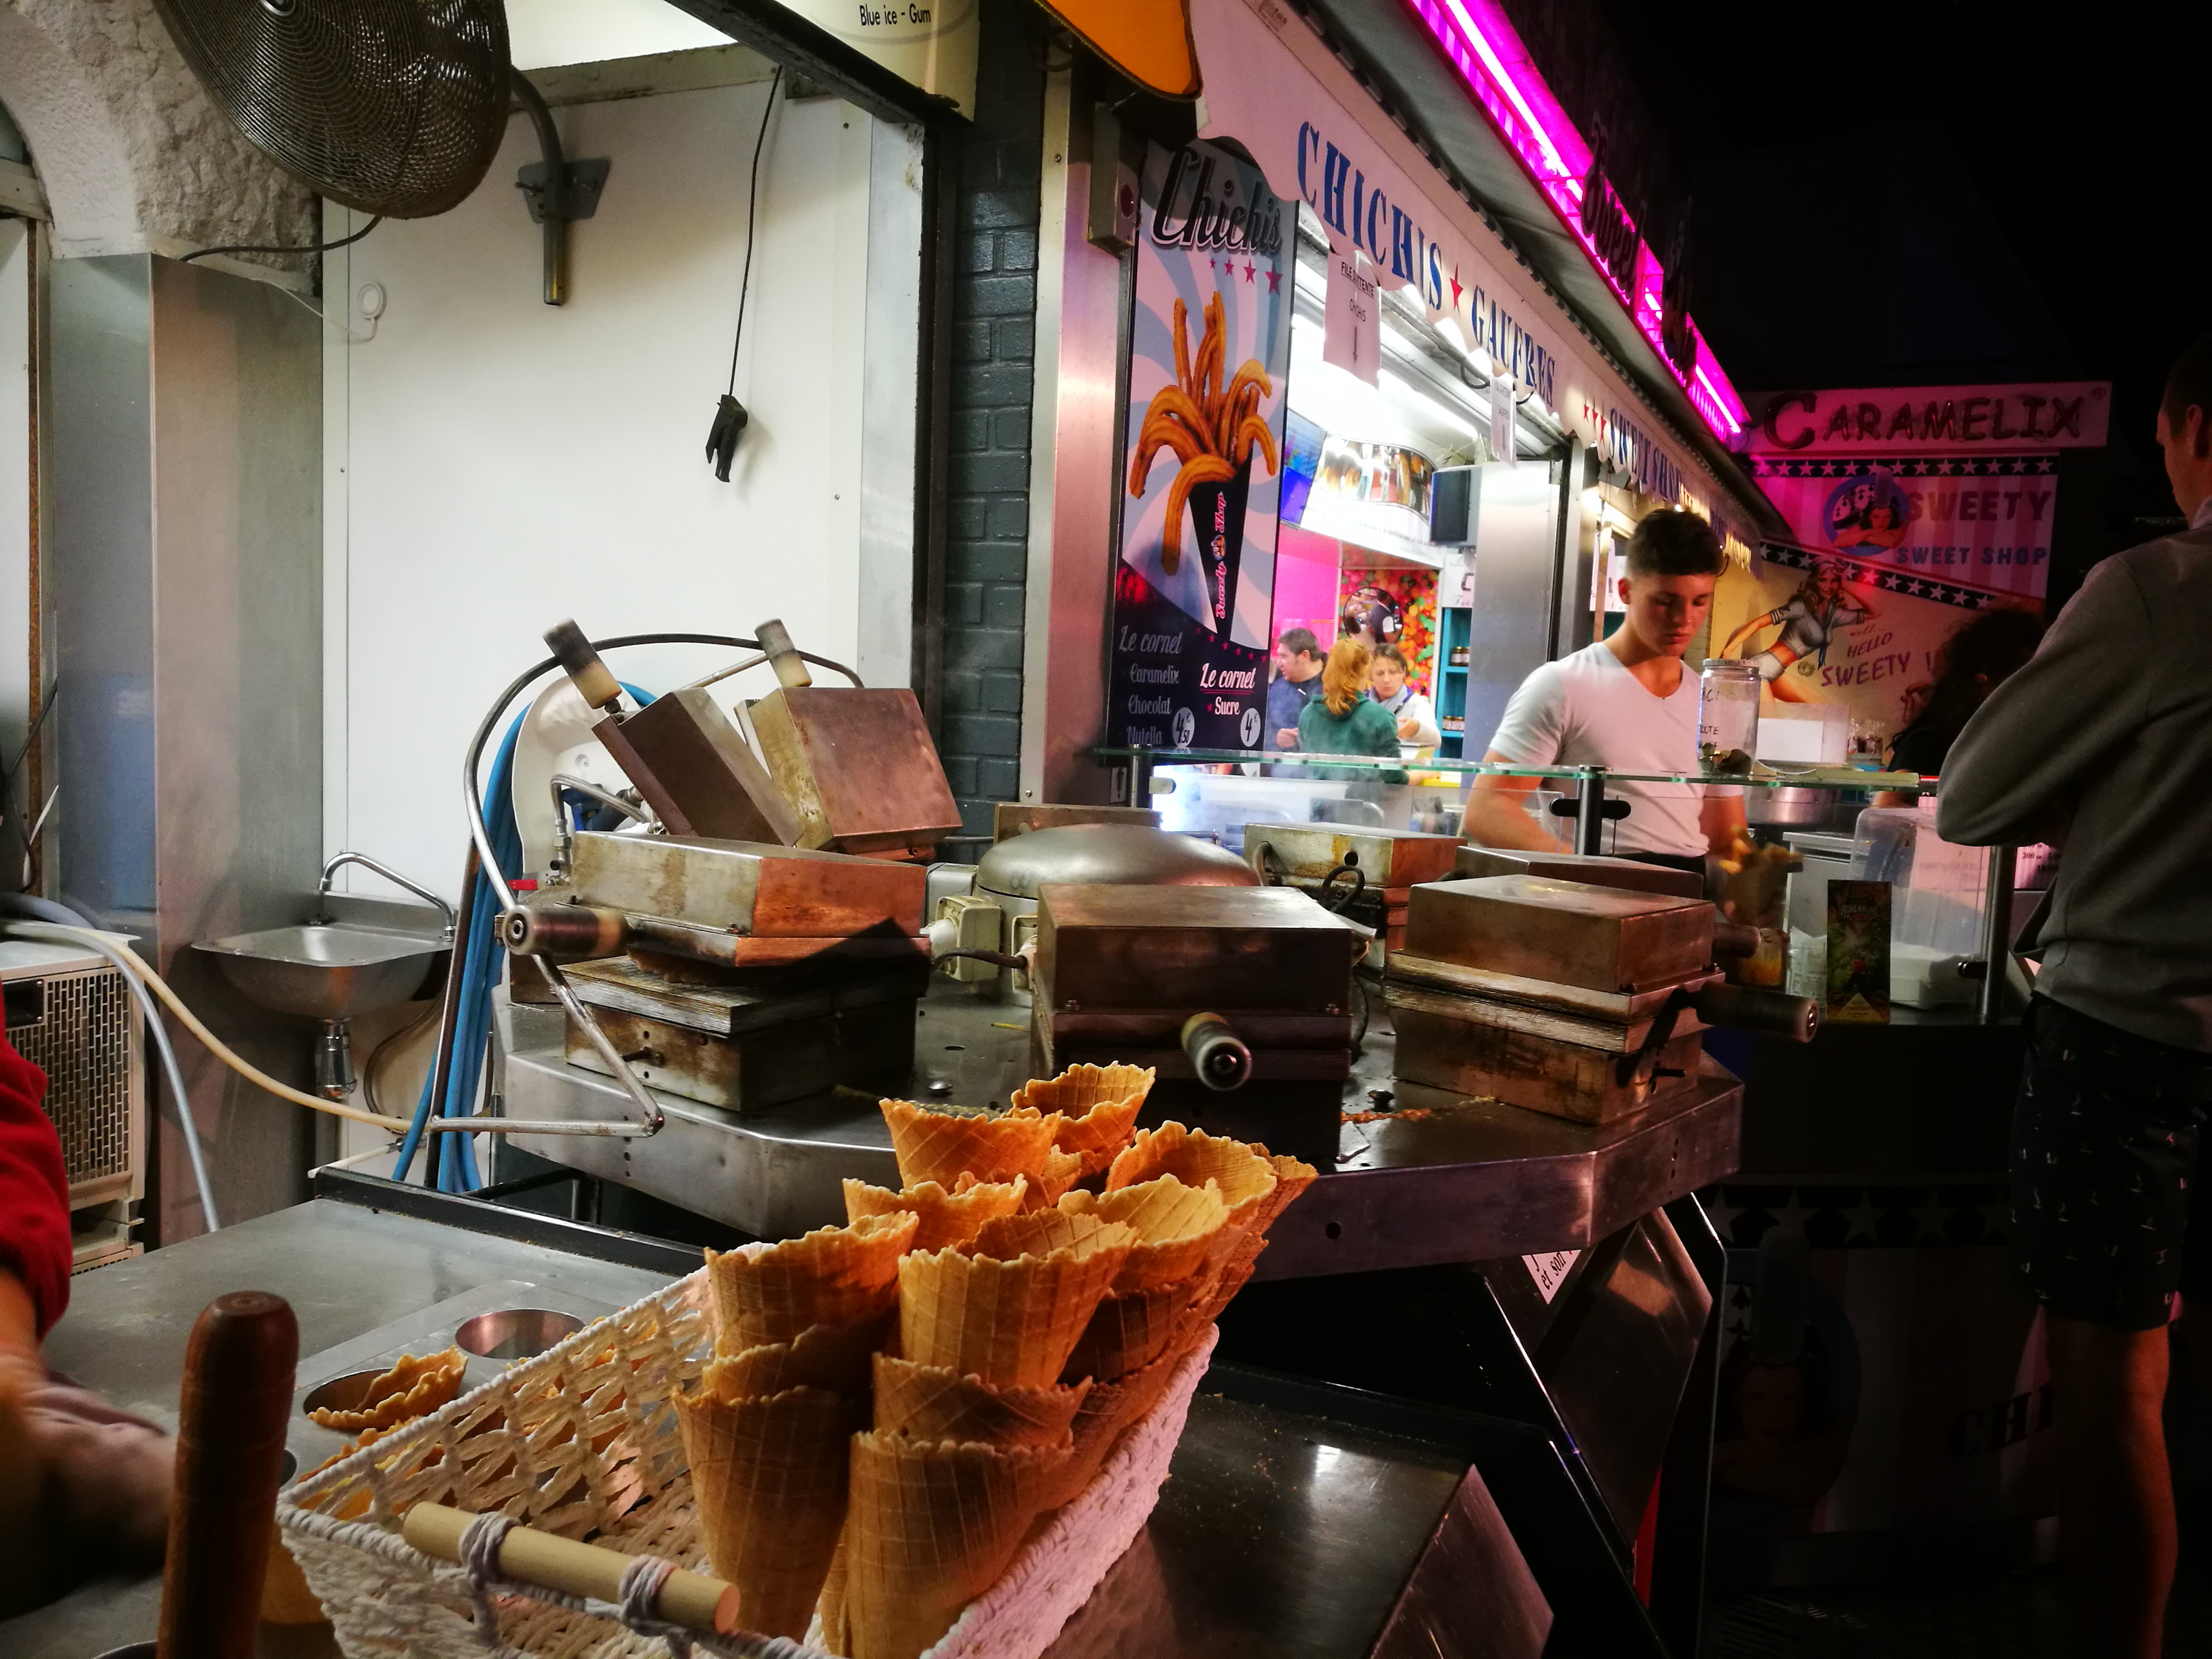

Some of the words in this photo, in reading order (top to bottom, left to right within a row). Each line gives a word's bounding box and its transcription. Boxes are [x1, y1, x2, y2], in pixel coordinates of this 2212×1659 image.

[859, 3, 881, 26] Blue
[883, 4, 898, 25] ice
[909, 3, 931, 24] Gum
[1152, 144, 1282, 251] Chichis
[1297, 121, 1443, 311] CHICHIS
[1471, 284, 1555, 408] GAUFRES
[1763, 391, 2084, 450] CARAMELIX
[1907, 491, 2052, 521] SWEETY
[1896, 546, 1970, 565] SWEET
[1981, 546, 2048, 565] SHOP
[1119, 625, 1138, 652] Le
[1140, 632, 1183, 654] cornet
[1846, 632, 1893, 658] HELLO
[1130, 663, 1180, 684] Caramelix
[1200, 662, 1217, 688] Le
[1219, 667, 1257, 689] cornet
[1821, 651, 1911, 687] SWEETY
[1127, 695, 1172, 715] Chocolat
[1214, 696, 1240, 715] Sucre
[1541, 1268, 1553, 1291] et
[1550, 1251, 1566, 1277] son
